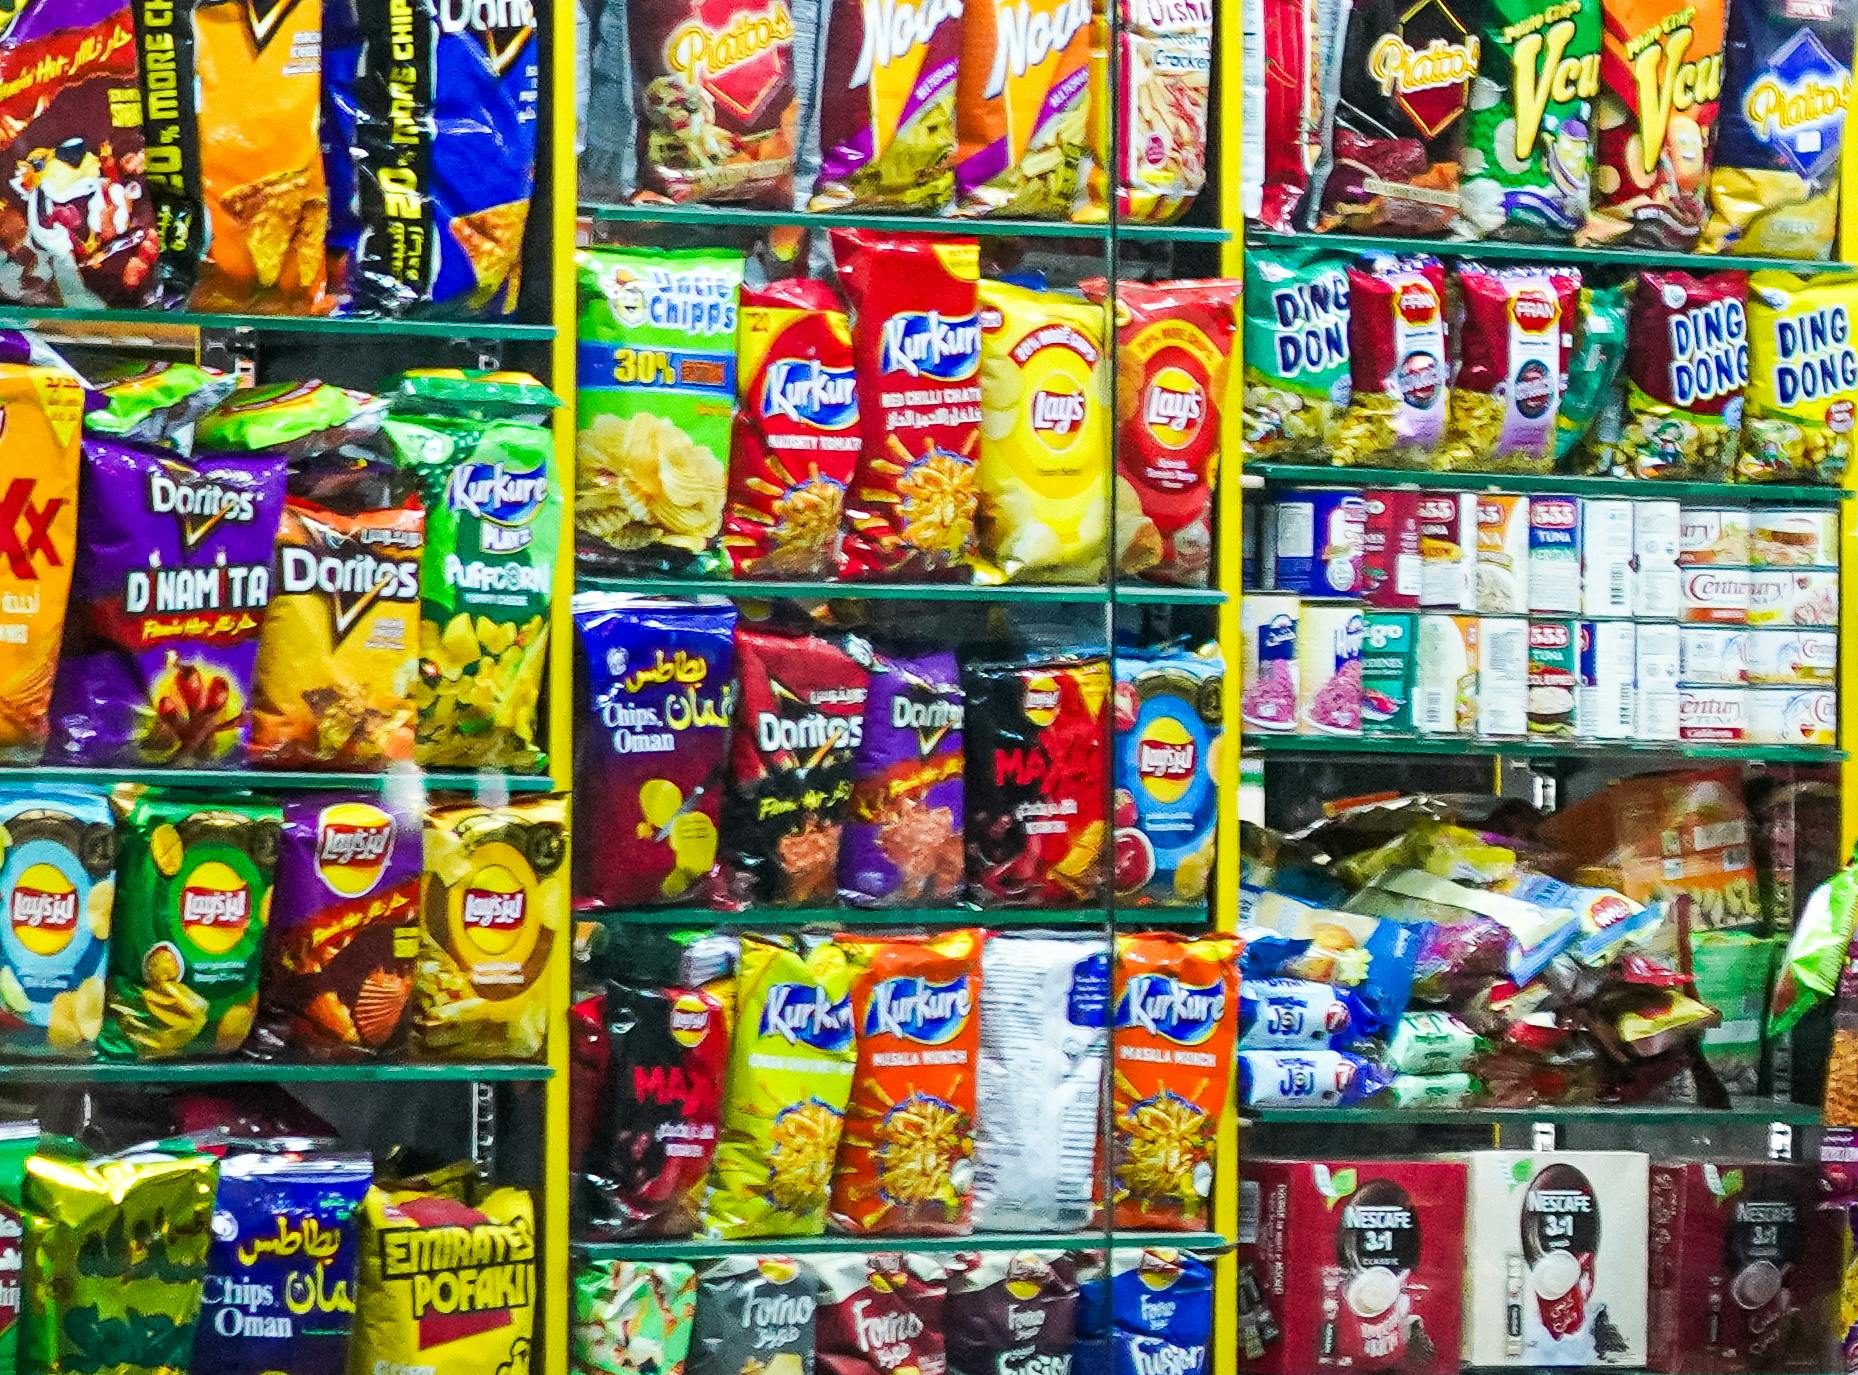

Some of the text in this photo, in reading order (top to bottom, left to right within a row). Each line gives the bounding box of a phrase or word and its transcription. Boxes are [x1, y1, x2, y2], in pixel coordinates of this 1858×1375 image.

[670, 0, 792, 81] Piattos
[1152, 48, 1211, 71] Cracke
[146, 31, 175, 122] MORE
[1510, 19, 1600, 161] Vcu
[1633, 24, 1722, 175] Vcu
[648, 294, 735, 334] Chipps
[1669, 298, 1745, 356] DING
[1777, 306, 1853, 360] DING
[612, 346, 678, 386] 30%
[885, 312, 983, 377] Kurkur
[1277, 326, 1350, 378] DON
[765, 361, 858, 424] Kurkur
[1777, 350, 1858, 407] DONG
[1032, 391, 1085, 435] Lay's
[1148, 386, 1204, 430] Lay's
[151, 472, 263, 522] Doritos
[450, 463, 547, 516] Kurkure
[1535, 504, 1575, 526] 555
[281, 544, 419, 599] Doritos
[1530, 624, 1567, 647] 555
[625, 650, 709, 692] بطاطس
[602, 701, 659, 732] Chips
[612, 726, 675, 753] Oman
[758, 713, 864, 752] Doritos
[877, 977, 971, 1034] Kurkure
[1127, 976, 1225, 1034] Kurkure
[873, 1049, 968, 1067] MASALA MUNCH
[238, 1216, 341, 1266] بطاطس
[200, 1275, 274, 1312] Chips
[214, 1307, 293, 1339] Oman
